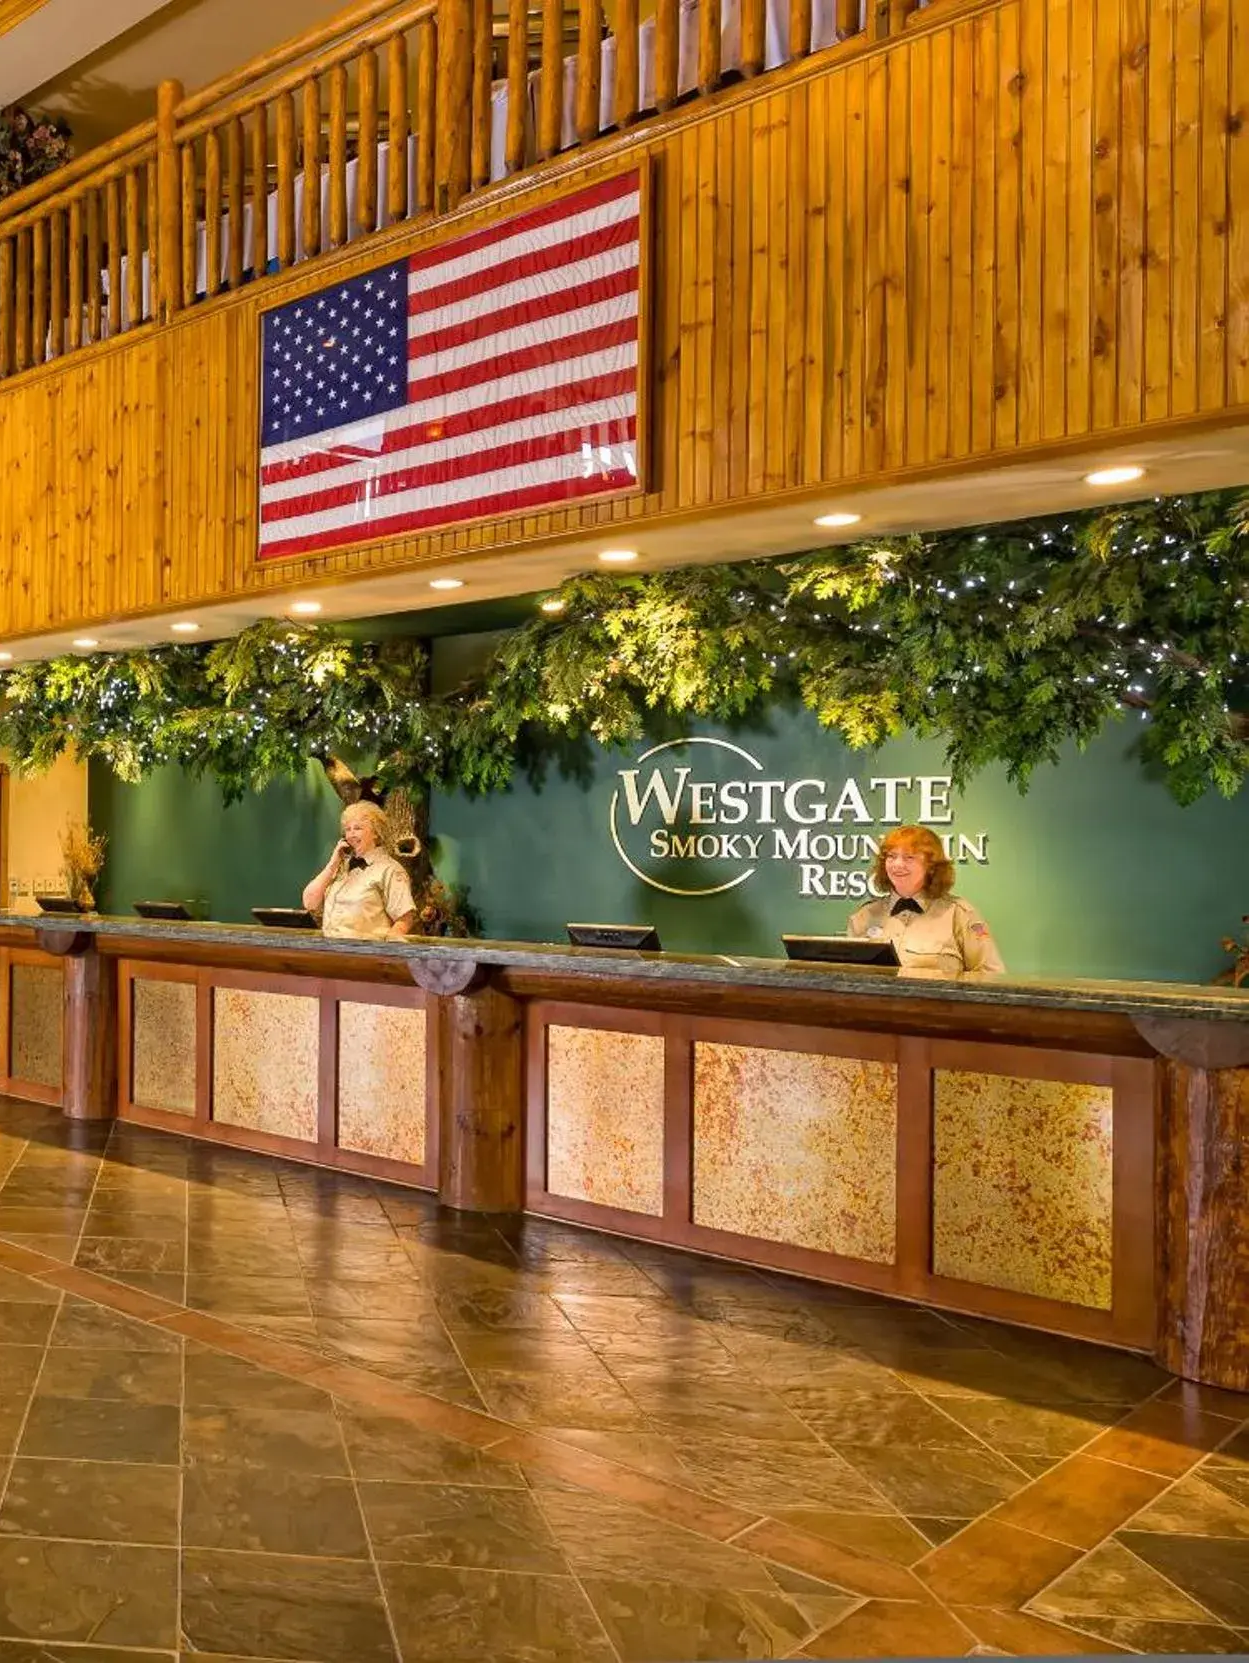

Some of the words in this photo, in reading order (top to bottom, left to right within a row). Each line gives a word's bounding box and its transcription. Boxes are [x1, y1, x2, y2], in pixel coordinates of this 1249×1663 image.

[617, 767, 953, 826] WESTGATE
[650, 828, 764, 859] SMOKY
[772, 829, 987, 861] MOUNIN
